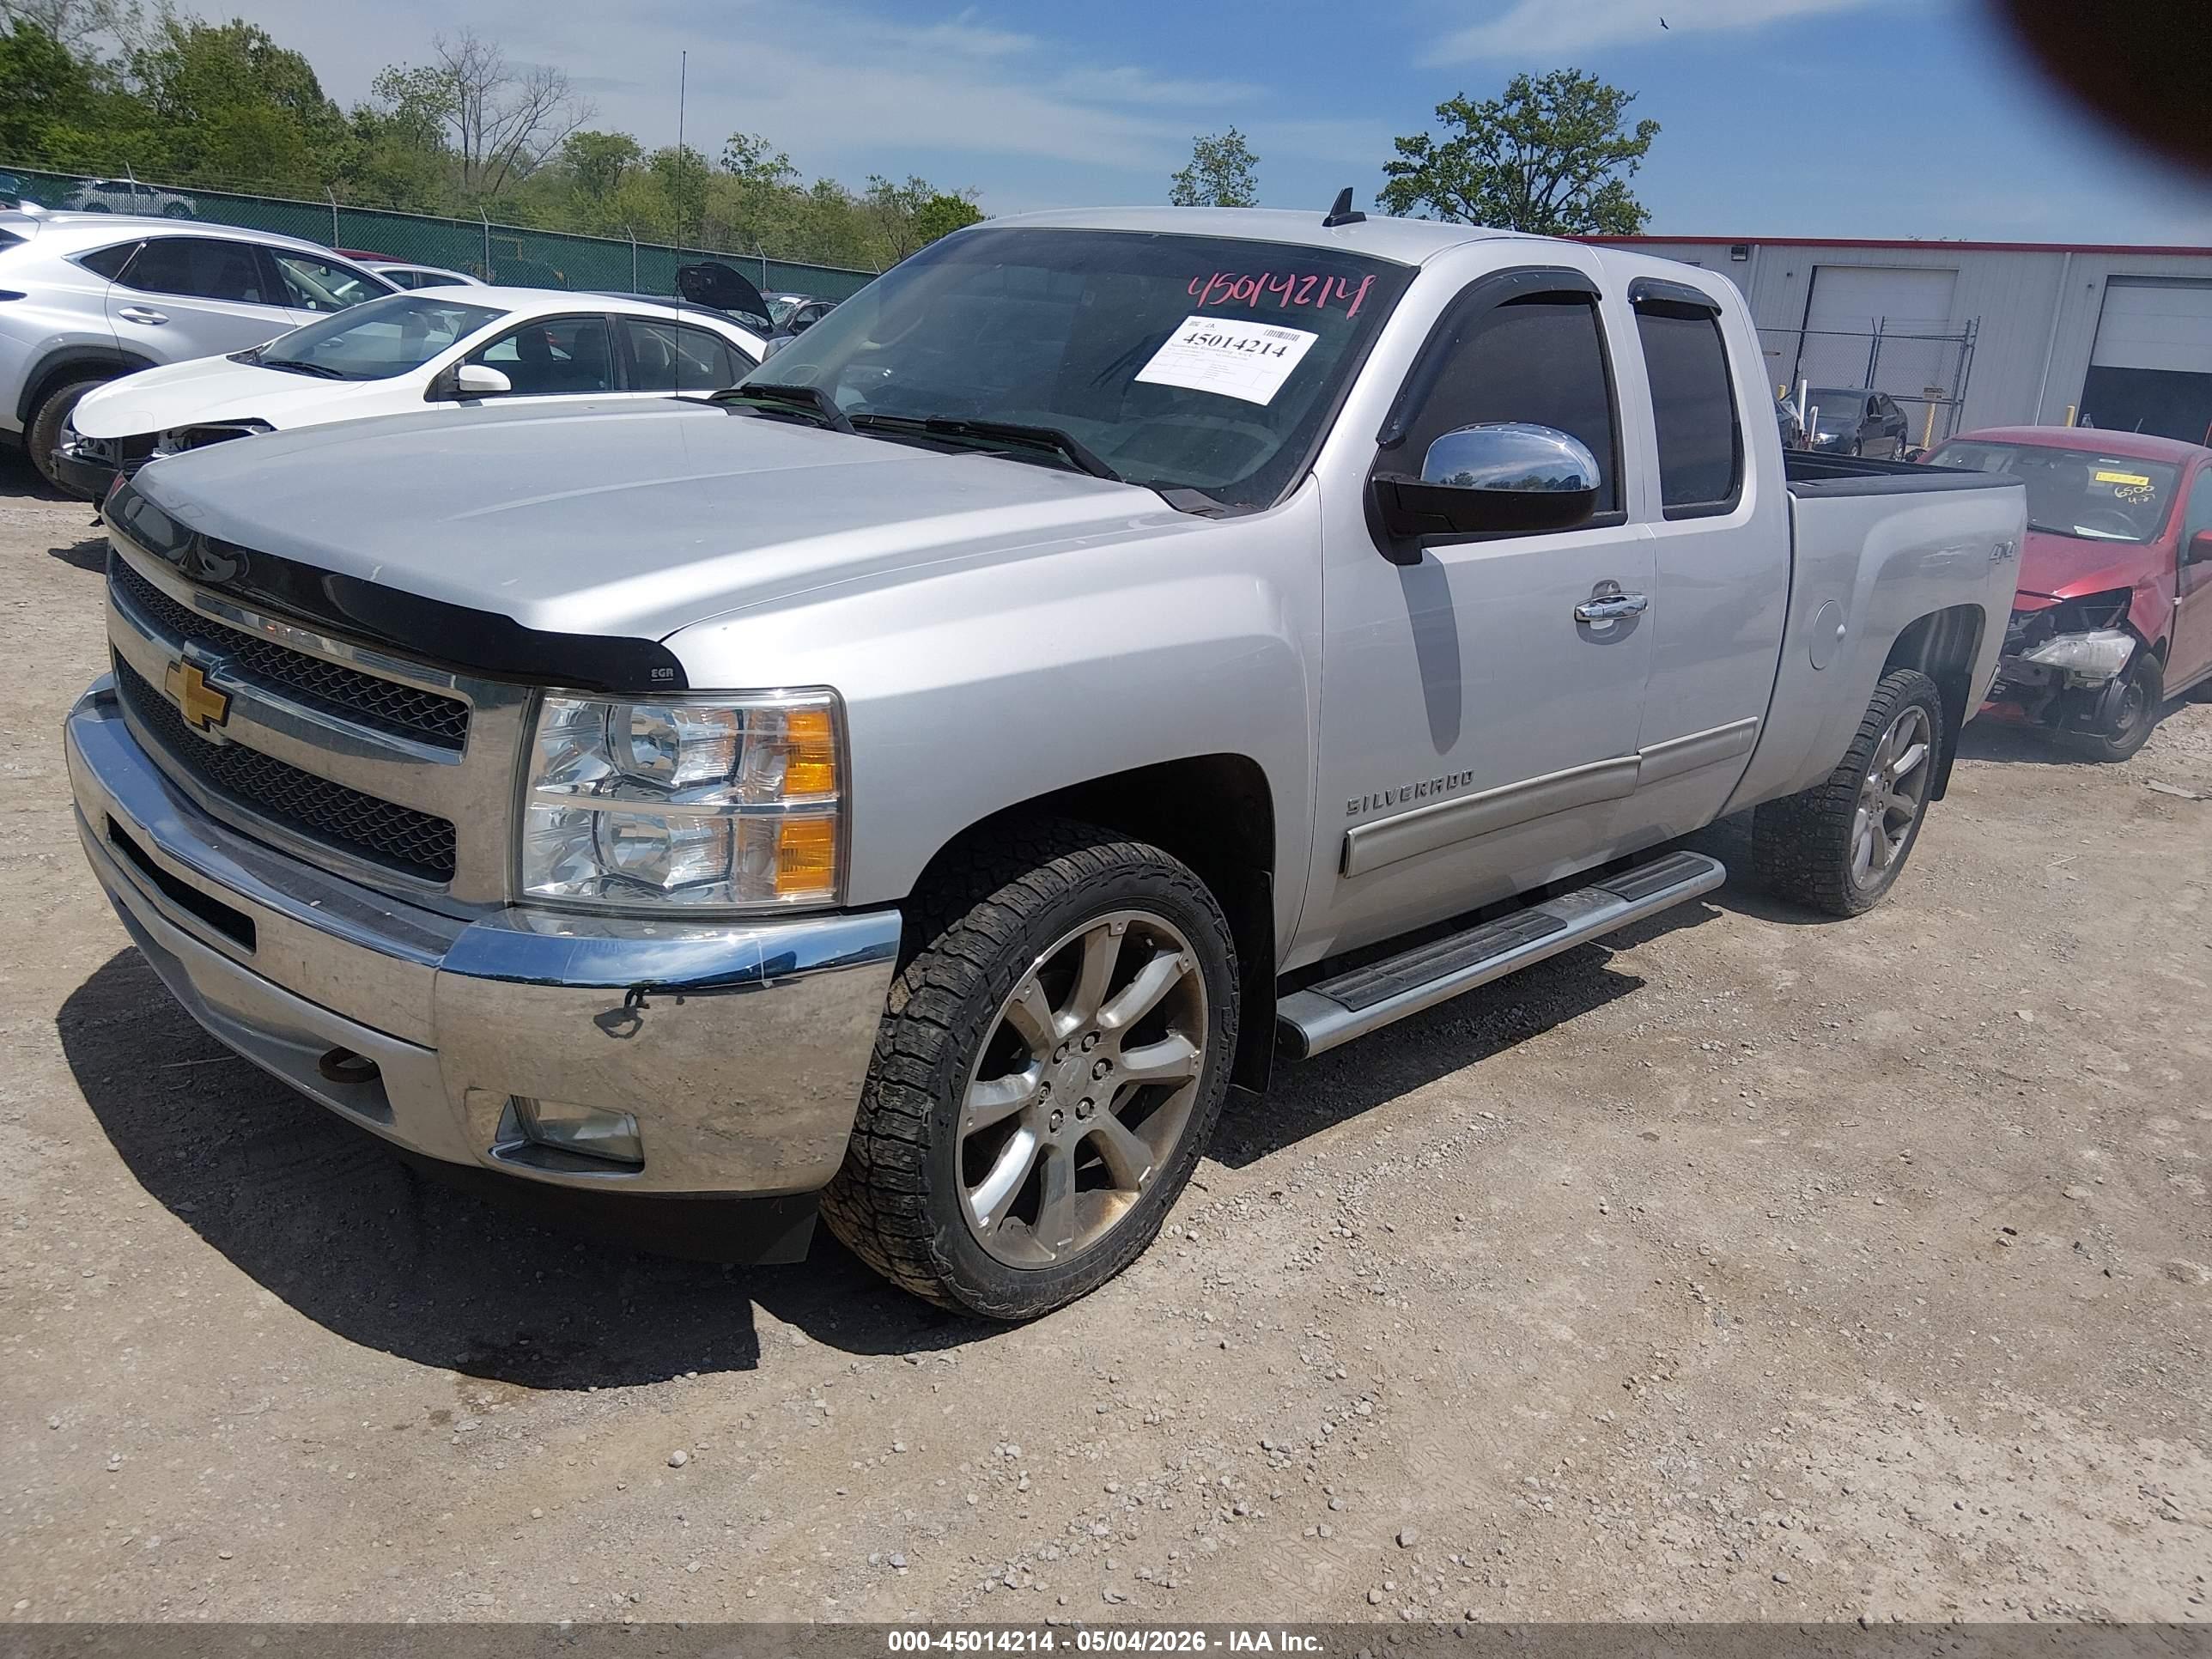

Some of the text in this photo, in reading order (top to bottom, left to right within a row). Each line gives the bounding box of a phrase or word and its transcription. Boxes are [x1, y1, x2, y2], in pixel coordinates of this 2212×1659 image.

[1188, 272, 1376, 321] 45014214
[1182, 332, 1288, 358] 45014214
[2114, 485, 2155, 498] 6500
[651, 668, 674, 678] EGR
[1346, 769, 1474, 816] SILVERADO
